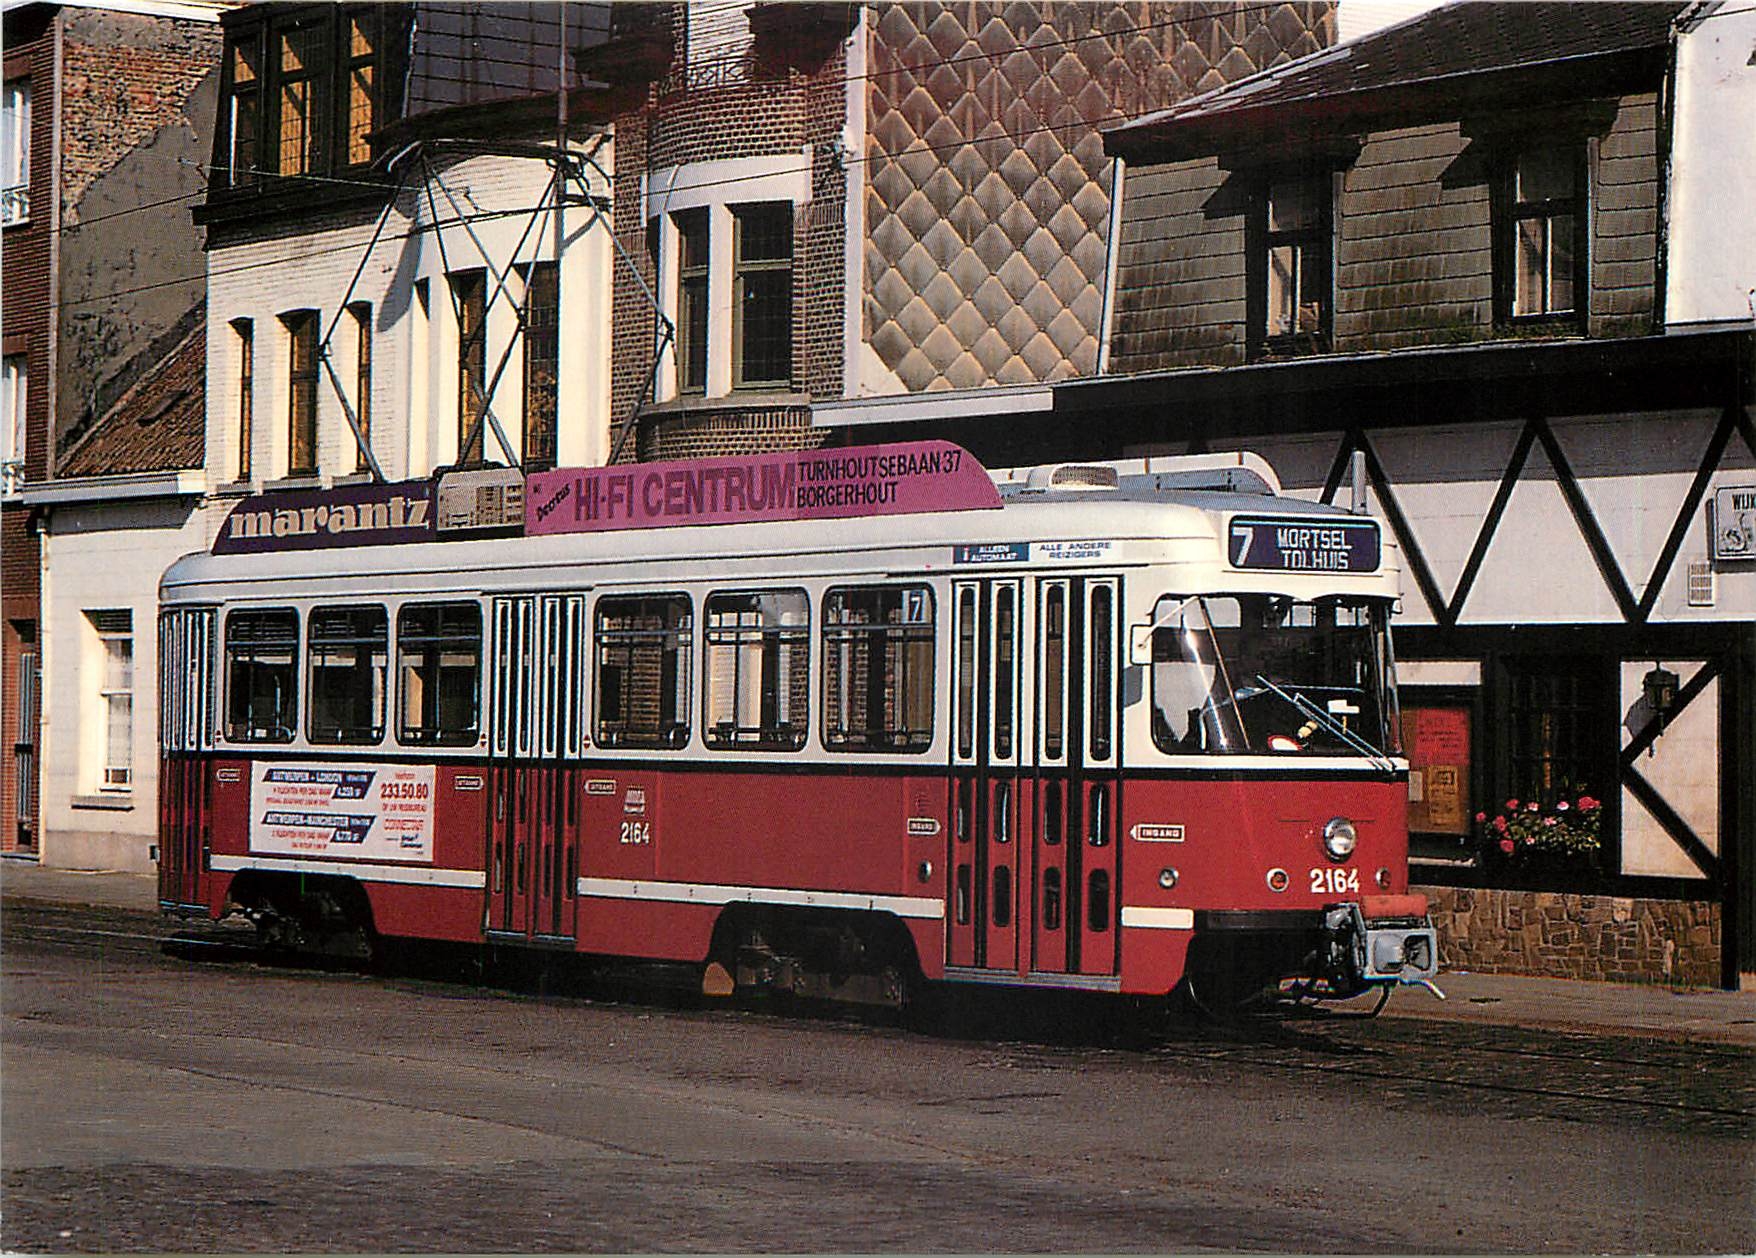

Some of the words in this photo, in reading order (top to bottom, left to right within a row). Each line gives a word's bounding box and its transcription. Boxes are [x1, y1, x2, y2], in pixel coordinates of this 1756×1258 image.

[799, 453, 940, 482] TURNHOUTSEBAAN
[943, 450, 963, 473] 37
[575, 473, 634, 521] HI-FI
[642, 462, 796, 518] CENTRUM
[797, 481, 898, 508] BORGERHOUT
[228, 497, 430, 538] marantz
[1039, 543, 1063, 551] ALLE
[1067, 541, 1113, 550] ANDERE
[1231, 526, 1254, 566] 7
[1276, 527, 1352, 549] MORTSEL
[1280, 549, 1349, 570] TOLHUIS
[911, 596, 923, 621] 7
[380, 782, 429, 799] 233.50.80
[620, 821, 650, 844] 2164
[1310, 868, 1360, 893] 2164
